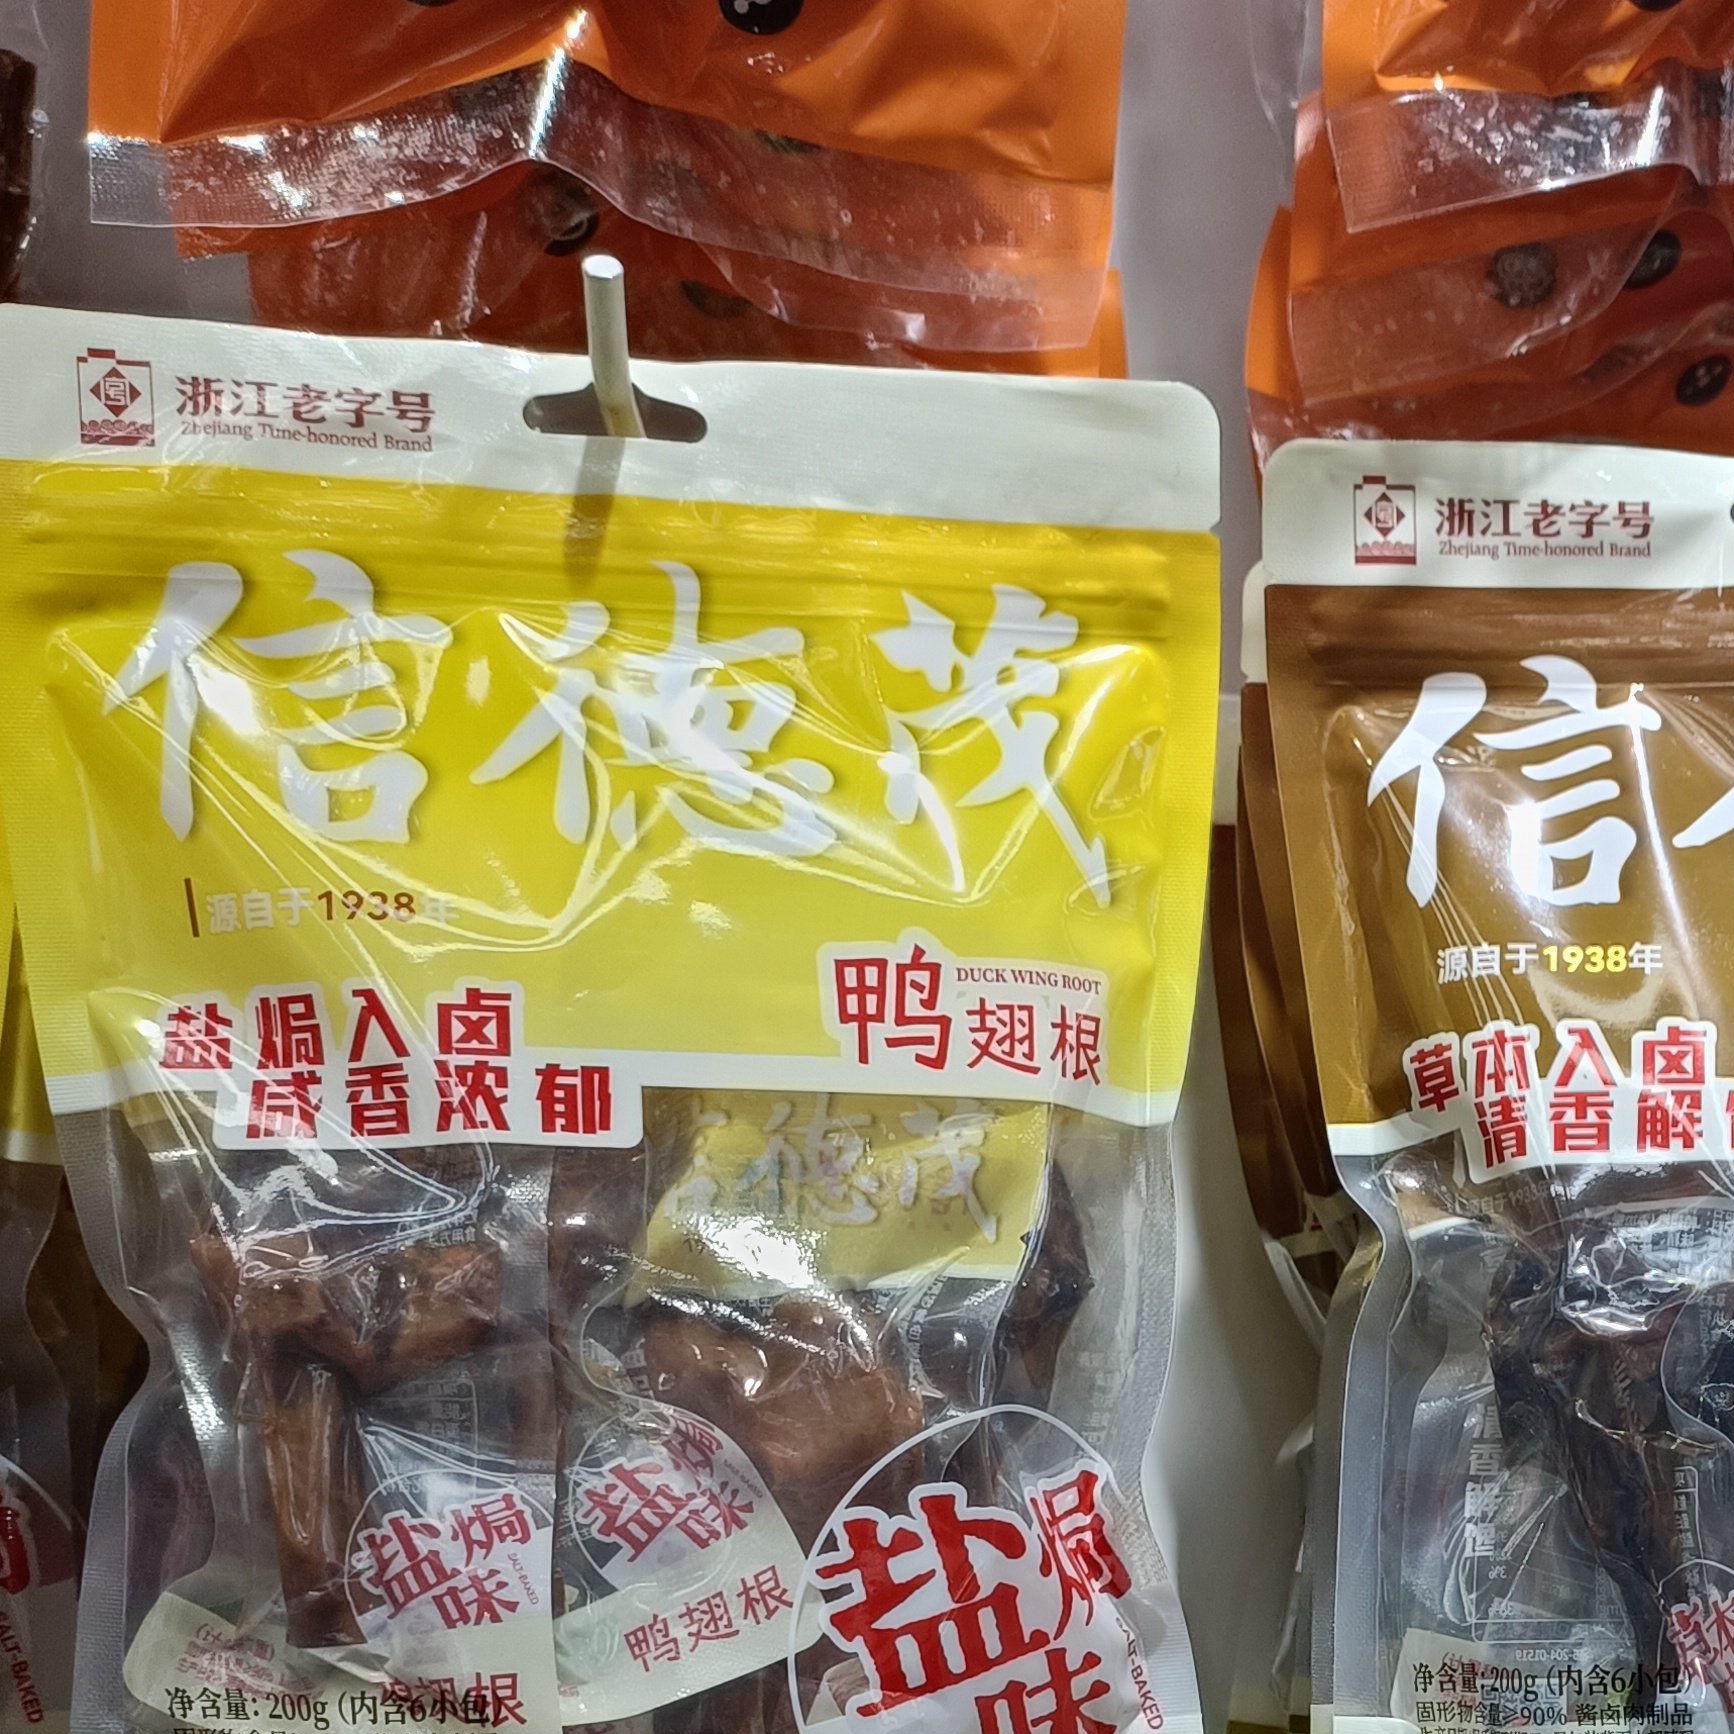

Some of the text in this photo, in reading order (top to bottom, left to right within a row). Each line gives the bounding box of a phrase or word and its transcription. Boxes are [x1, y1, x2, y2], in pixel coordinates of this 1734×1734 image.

[176, 376, 435, 432] 浙江老字号
[179, 420, 433, 452] Zhejiang Time-honored Brand
[1435, 498, 1654, 539] 浙江老字号
[1439, 541, 1651, 560] Zhejiang Time-honored Brand
[103, 550, 1110, 908] 信德茂
[956, 967, 1102, 995] DUCK WING ROOT
[1437, 943, 1663, 984] 源自于1938年
[159, 987, 513, 1071] 盐焗入卤
[834, 945, 1102, 1085] 鸭翅根
[246, 1059, 612, 1138] 咸香浓郁
[1410, 1027, 1707, 1112] 草本入卤
[363, 1494, 532, 1630] 盐焗味
[625, 1566, 794, 1672] 鸭翅根
[1576, 1703, 1693, 1727] 酱卤肉制品
